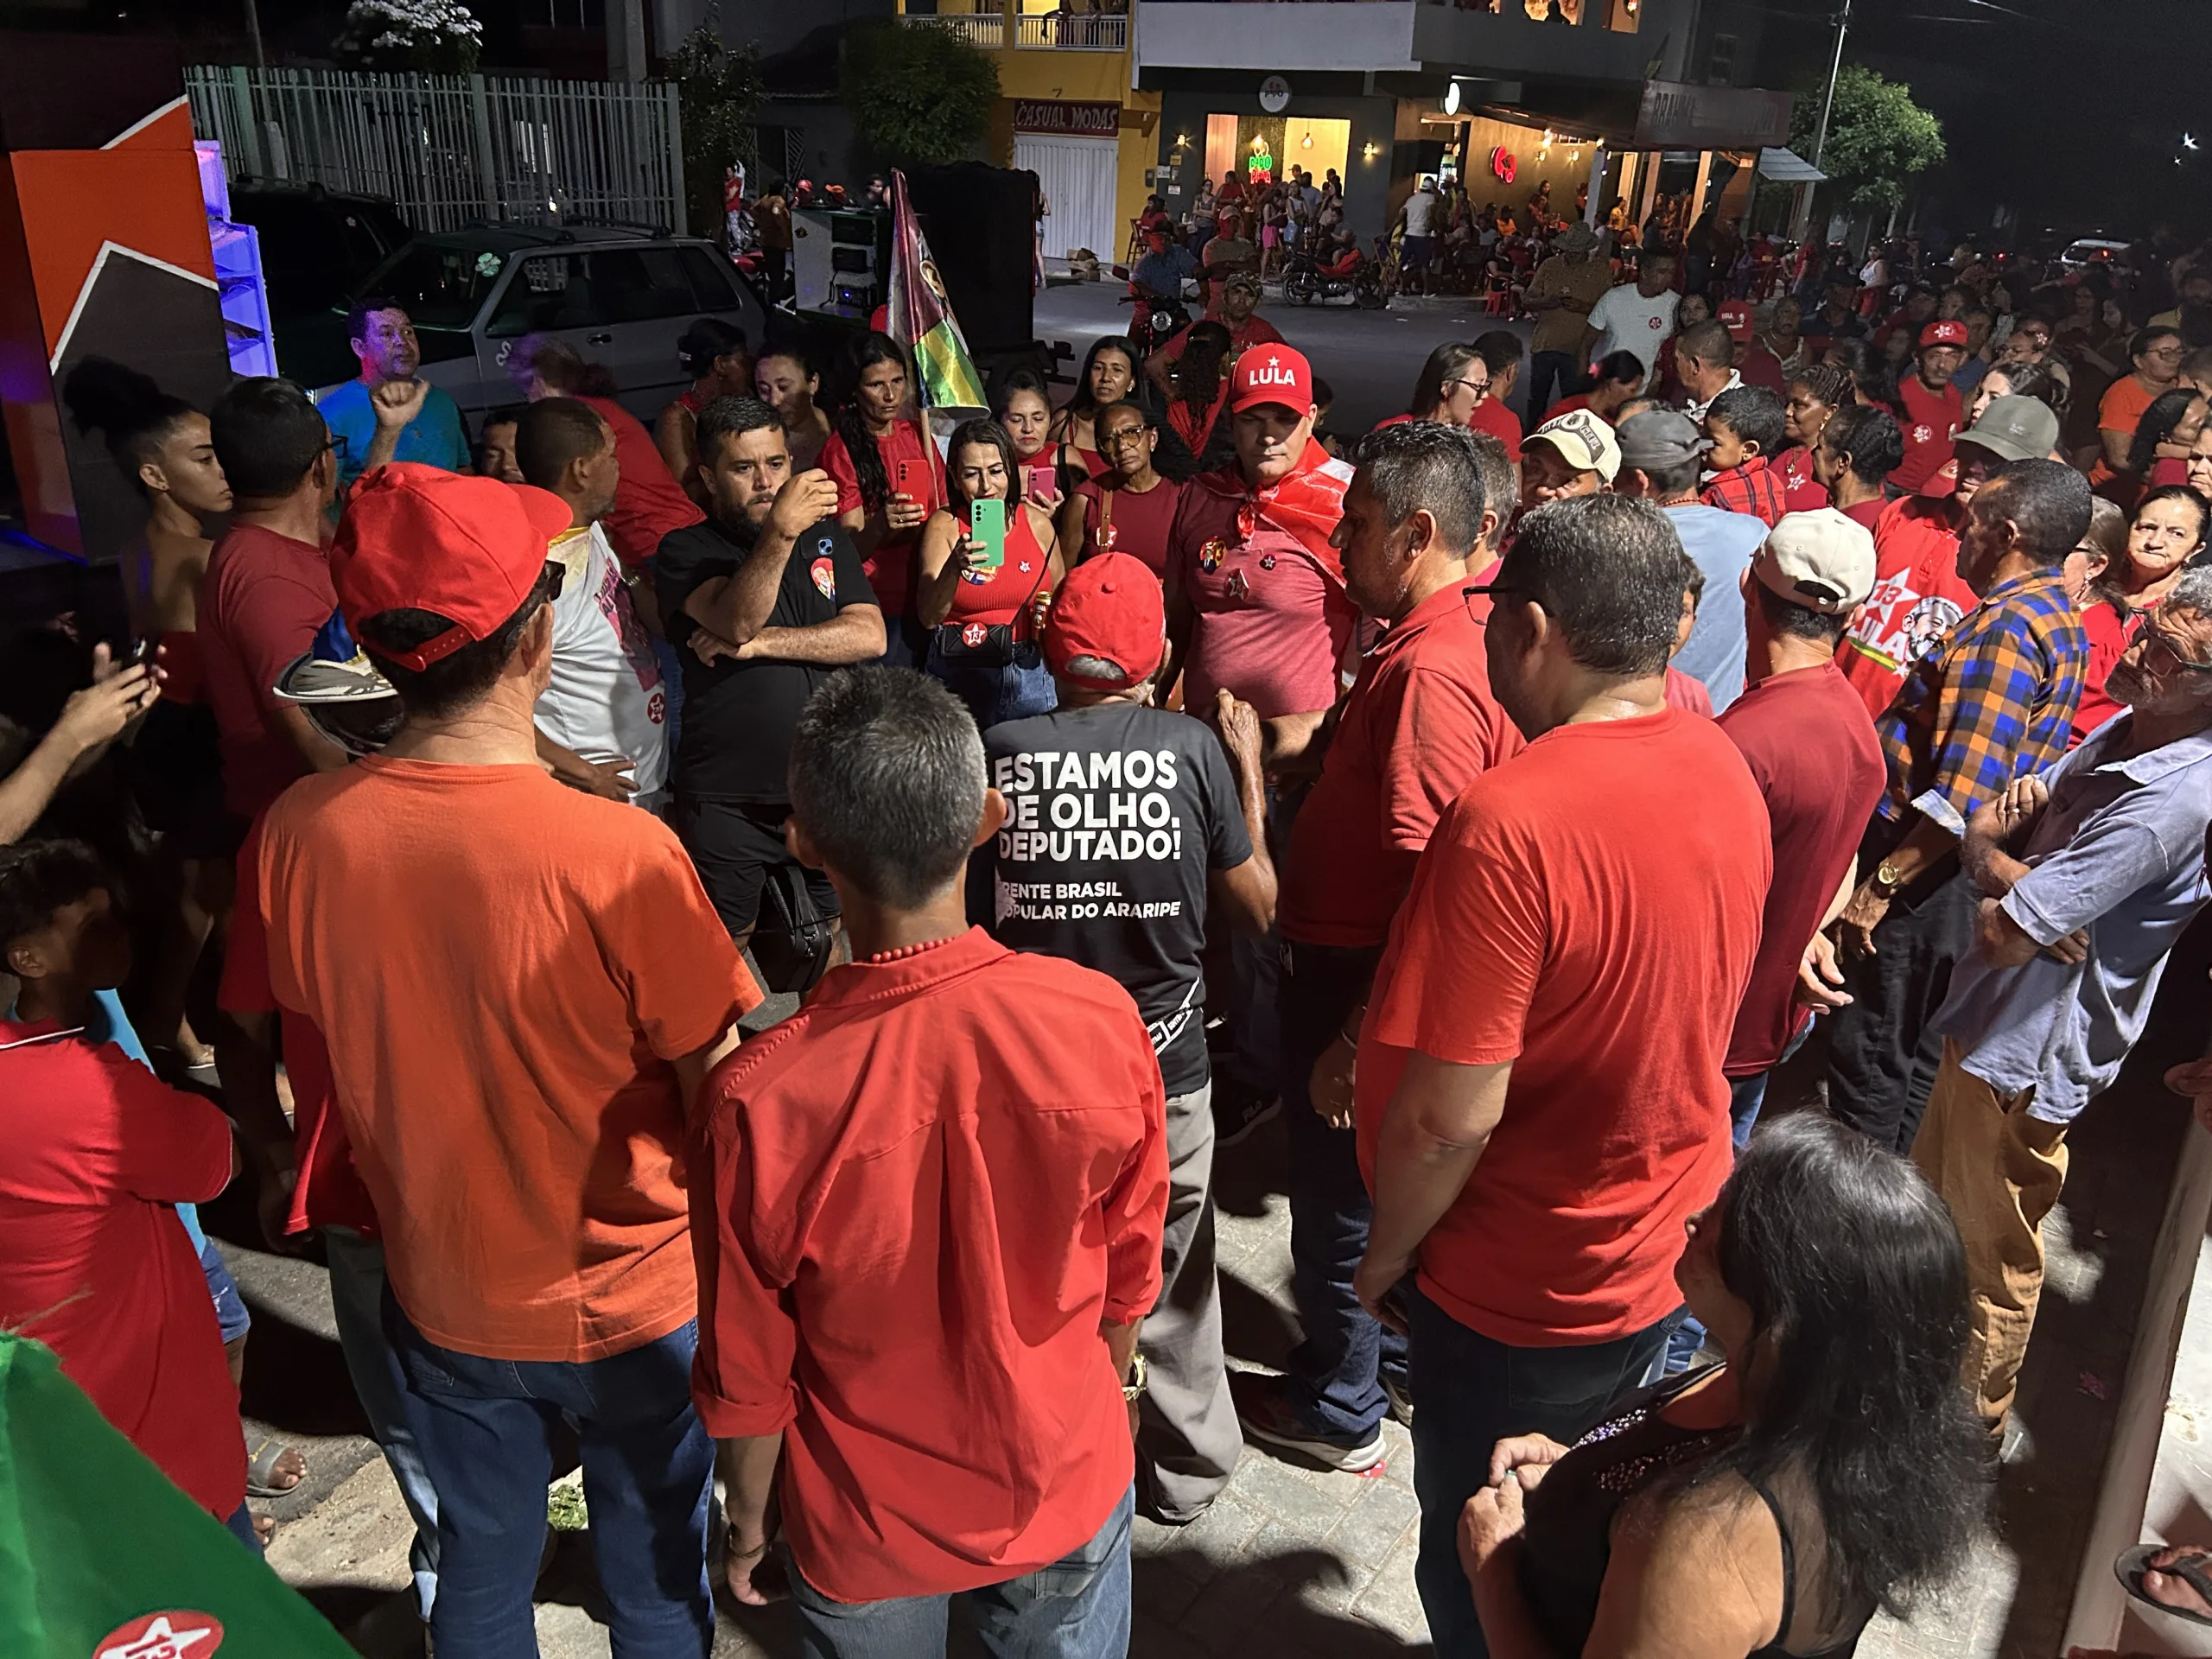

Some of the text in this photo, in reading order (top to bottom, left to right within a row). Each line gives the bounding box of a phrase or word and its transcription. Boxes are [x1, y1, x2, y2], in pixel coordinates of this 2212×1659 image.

[1015, 104, 1118, 130] CASUAL MODAS
[1249, 367, 1296, 386] LULA
[1872, 583, 1903, 605] 13
[969, 631, 980, 640] 13
[1846, 615, 1910, 662] LULA
[995, 750, 1178, 792] ESTAMOS
[999, 792, 1180, 830] DE OLHO.
[999, 830, 1181, 861] DEPUTADO!
[999, 881, 1122, 899] RENTE BRASIL
[1002, 900, 1181, 920] OPULAR DO ARARIPE
